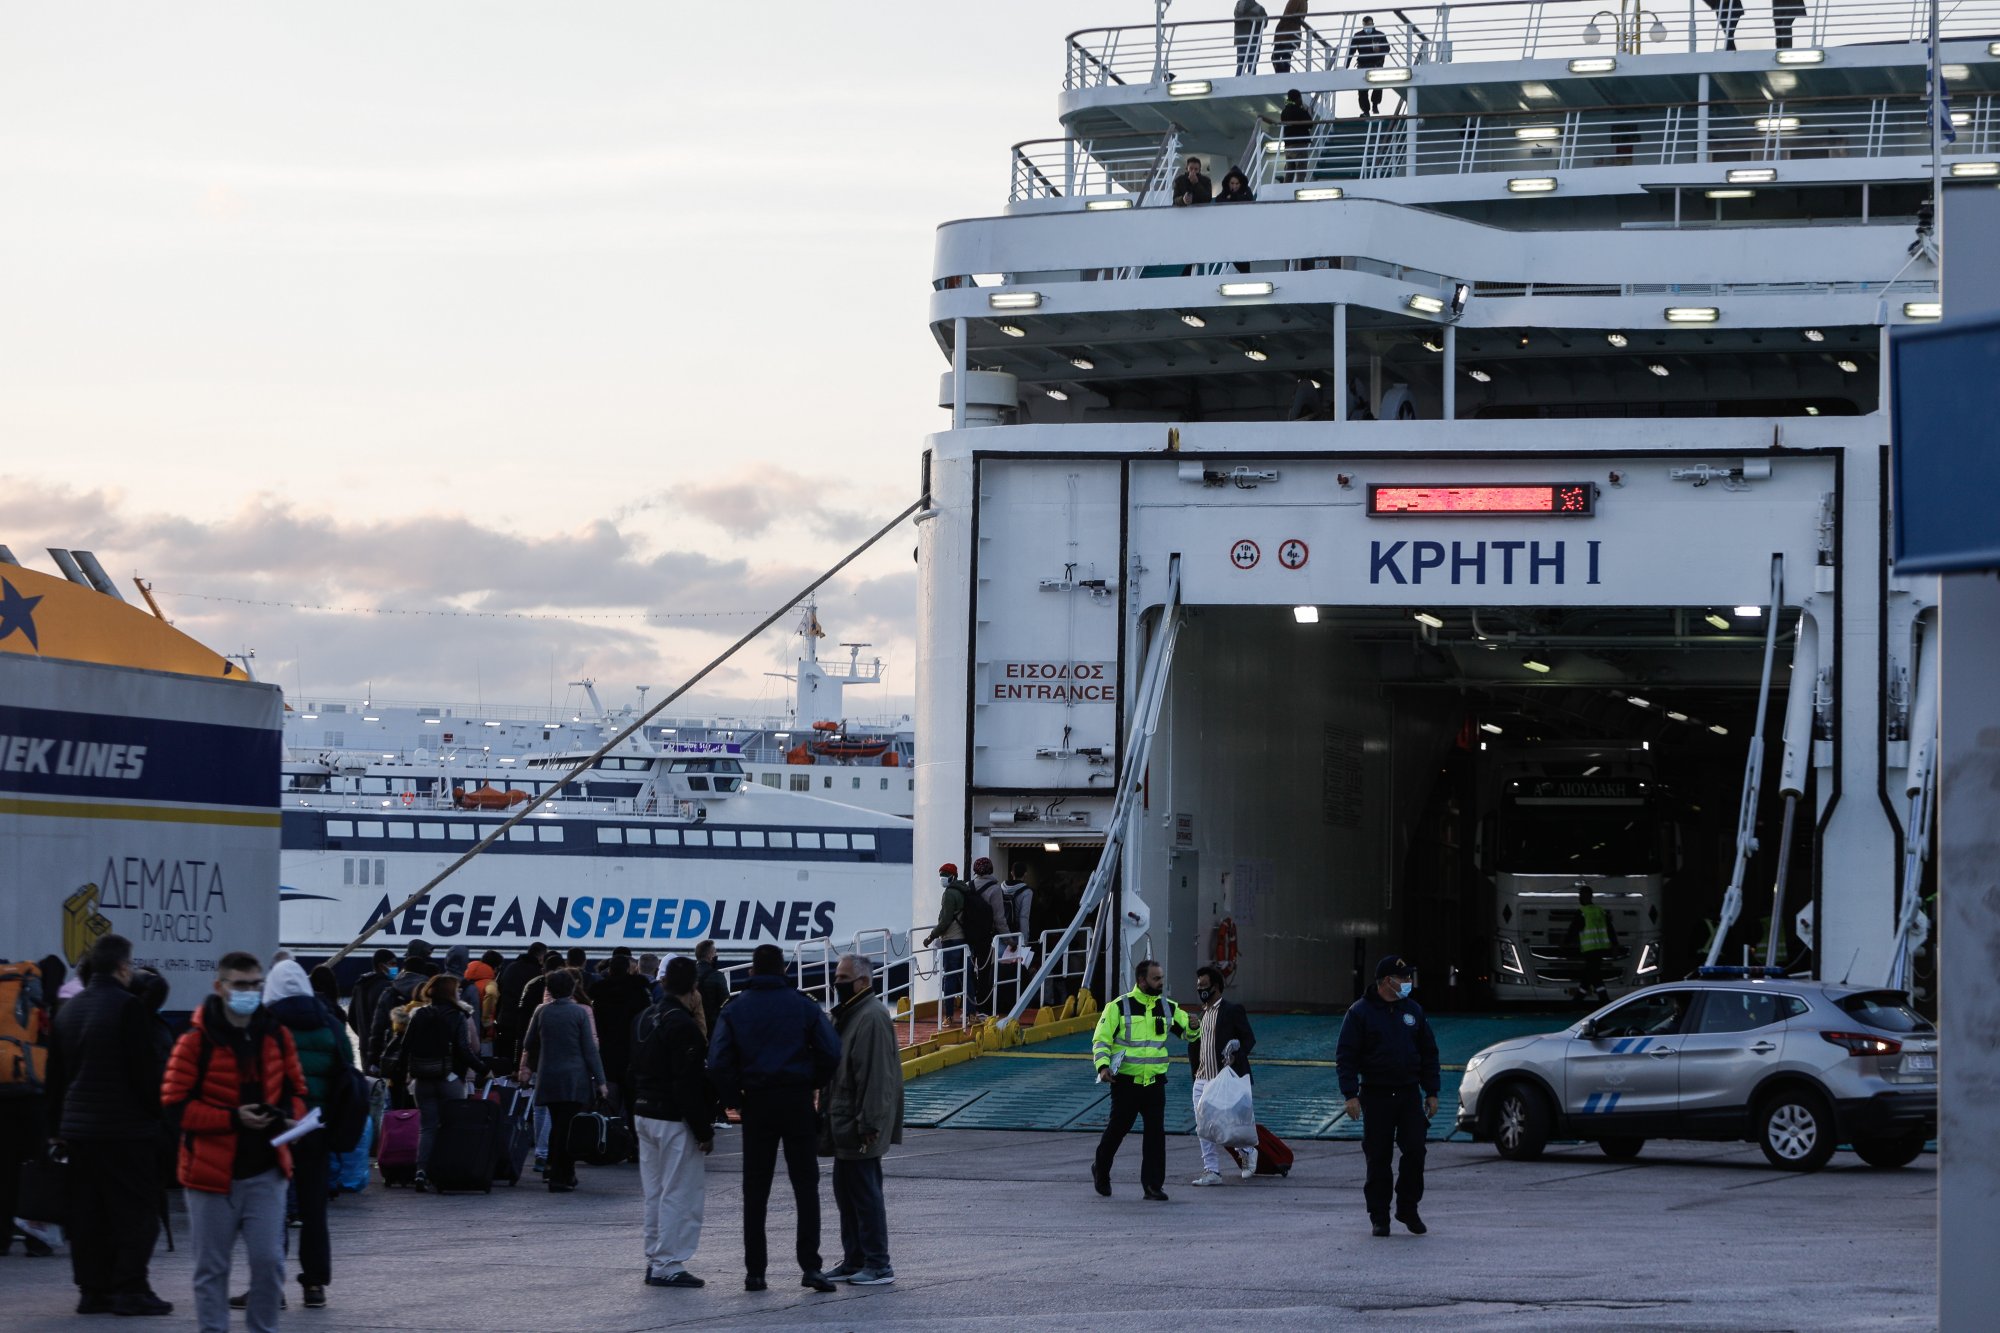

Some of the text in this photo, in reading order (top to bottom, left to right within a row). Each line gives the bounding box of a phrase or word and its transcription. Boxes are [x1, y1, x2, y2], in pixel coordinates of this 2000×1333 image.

[1370, 540, 1565, 585] ΚΡΗΤΗ
[1006, 664, 1104, 679] ΕΙΣΟΔΟΣ
[994, 684, 1115, 700] ENTRANCE
[0, 735, 147, 779] EK LINES
[99, 857, 227, 912] ΔΕΜΑΤΑ
[143, 913, 213, 943] PARCELS
